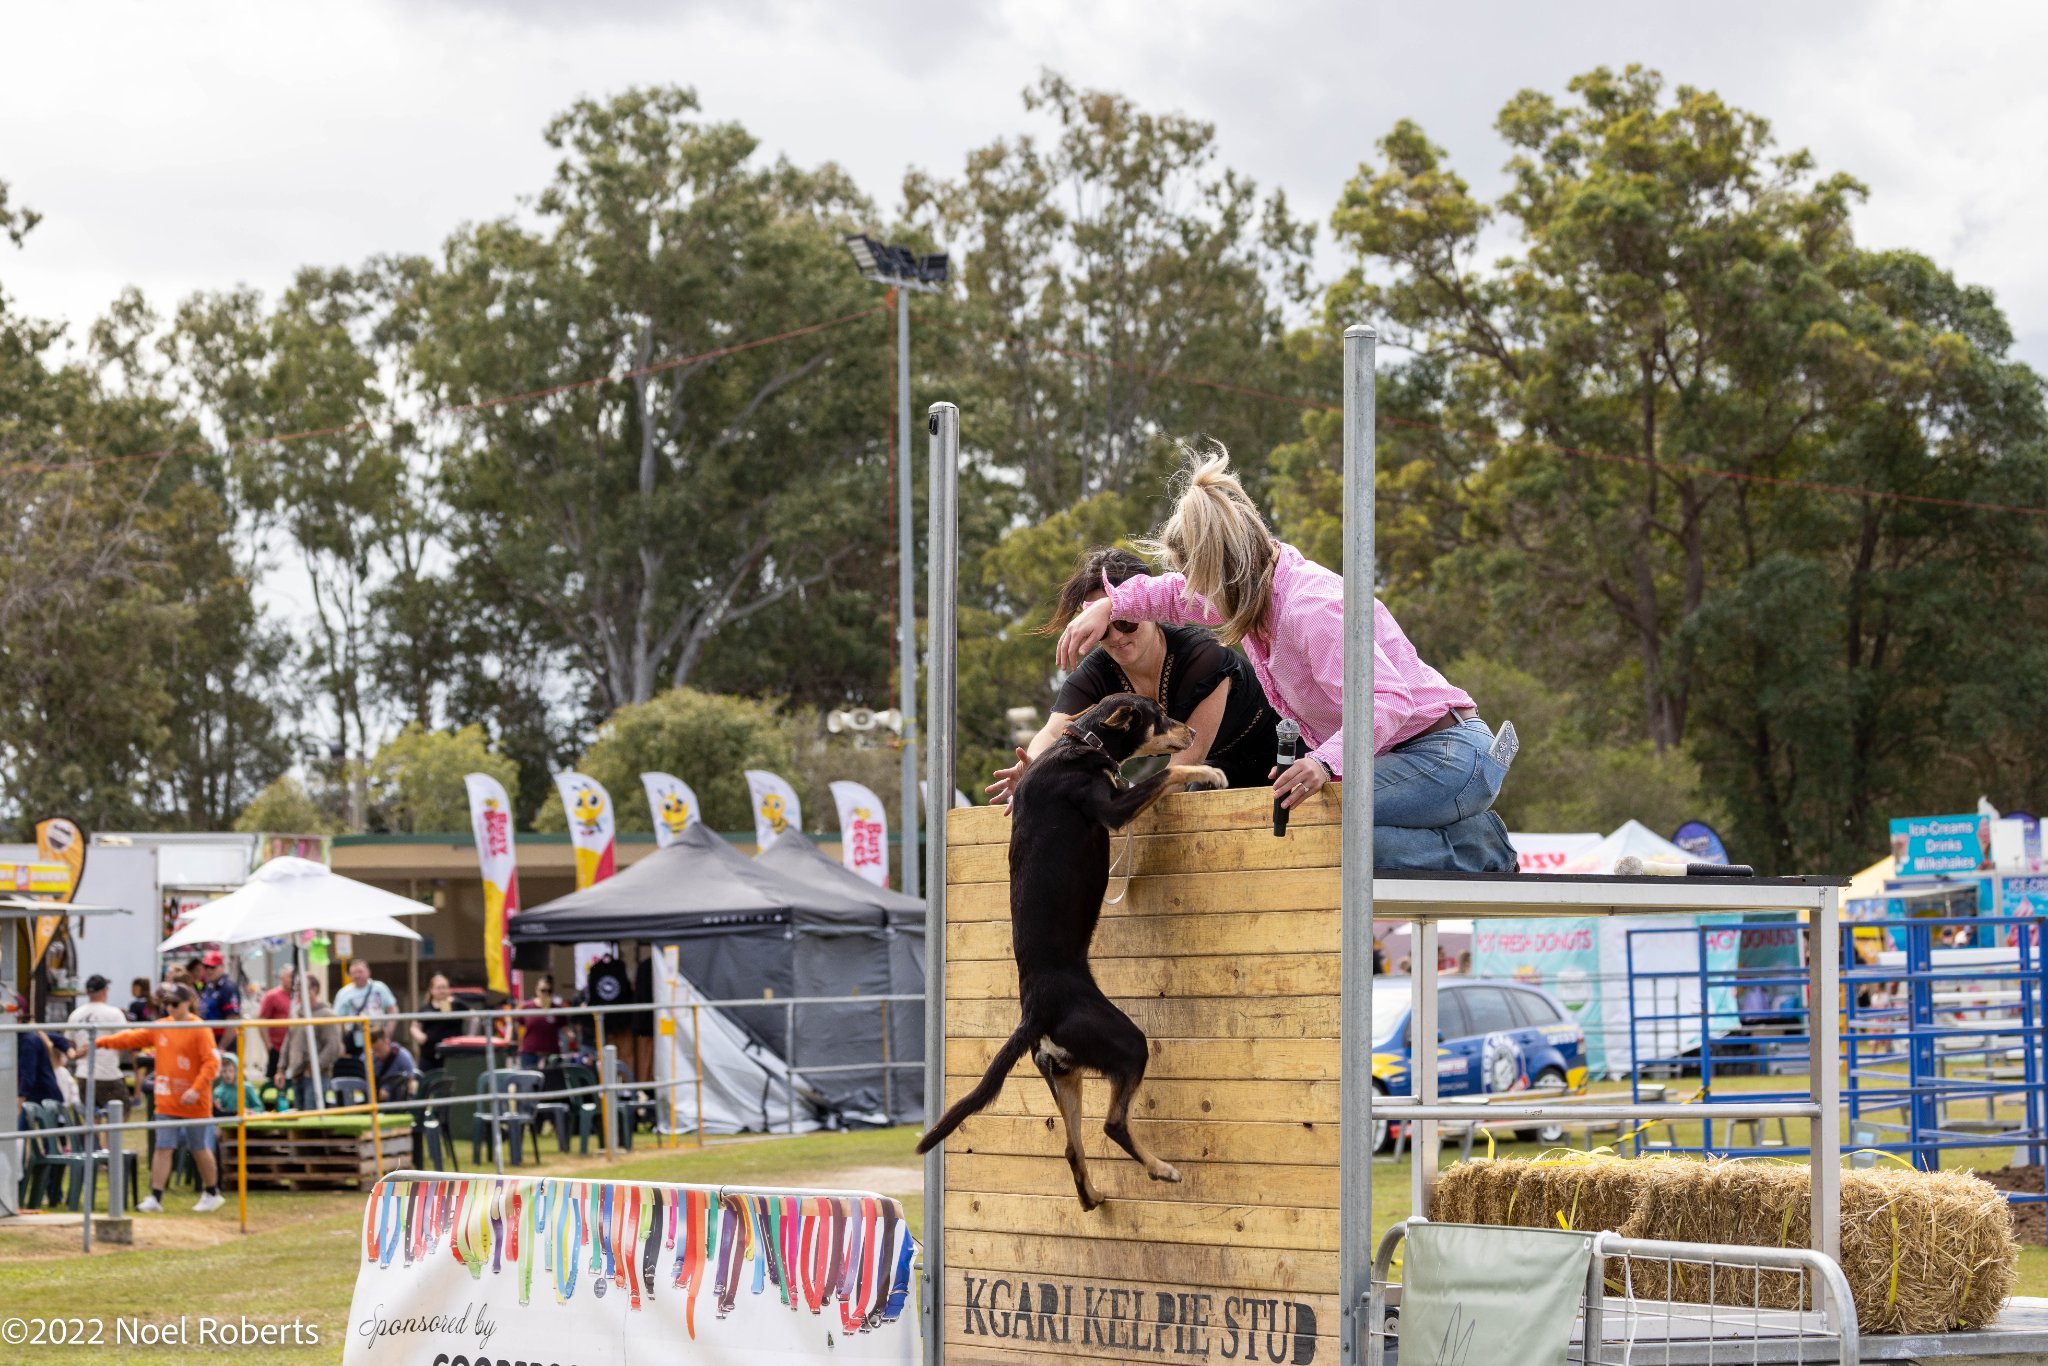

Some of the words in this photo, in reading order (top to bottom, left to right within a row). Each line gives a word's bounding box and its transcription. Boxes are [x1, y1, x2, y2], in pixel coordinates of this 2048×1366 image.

[1909, 821, 1974, 836] Ice-Creams
[1925, 838, 1963, 853] Drinks
[1914, 856, 1975, 871] Milkshakes
[1535, 929, 1592, 953] DONUTS
[359, 1302, 473, 1350] Sponsored
[474, 1303, 498, 1350] by
[963, 1275, 1073, 1344] KGARI
[1081, 1286, 1211, 1355] KELPIE
[1220, 1296, 1317, 1366] STUD
